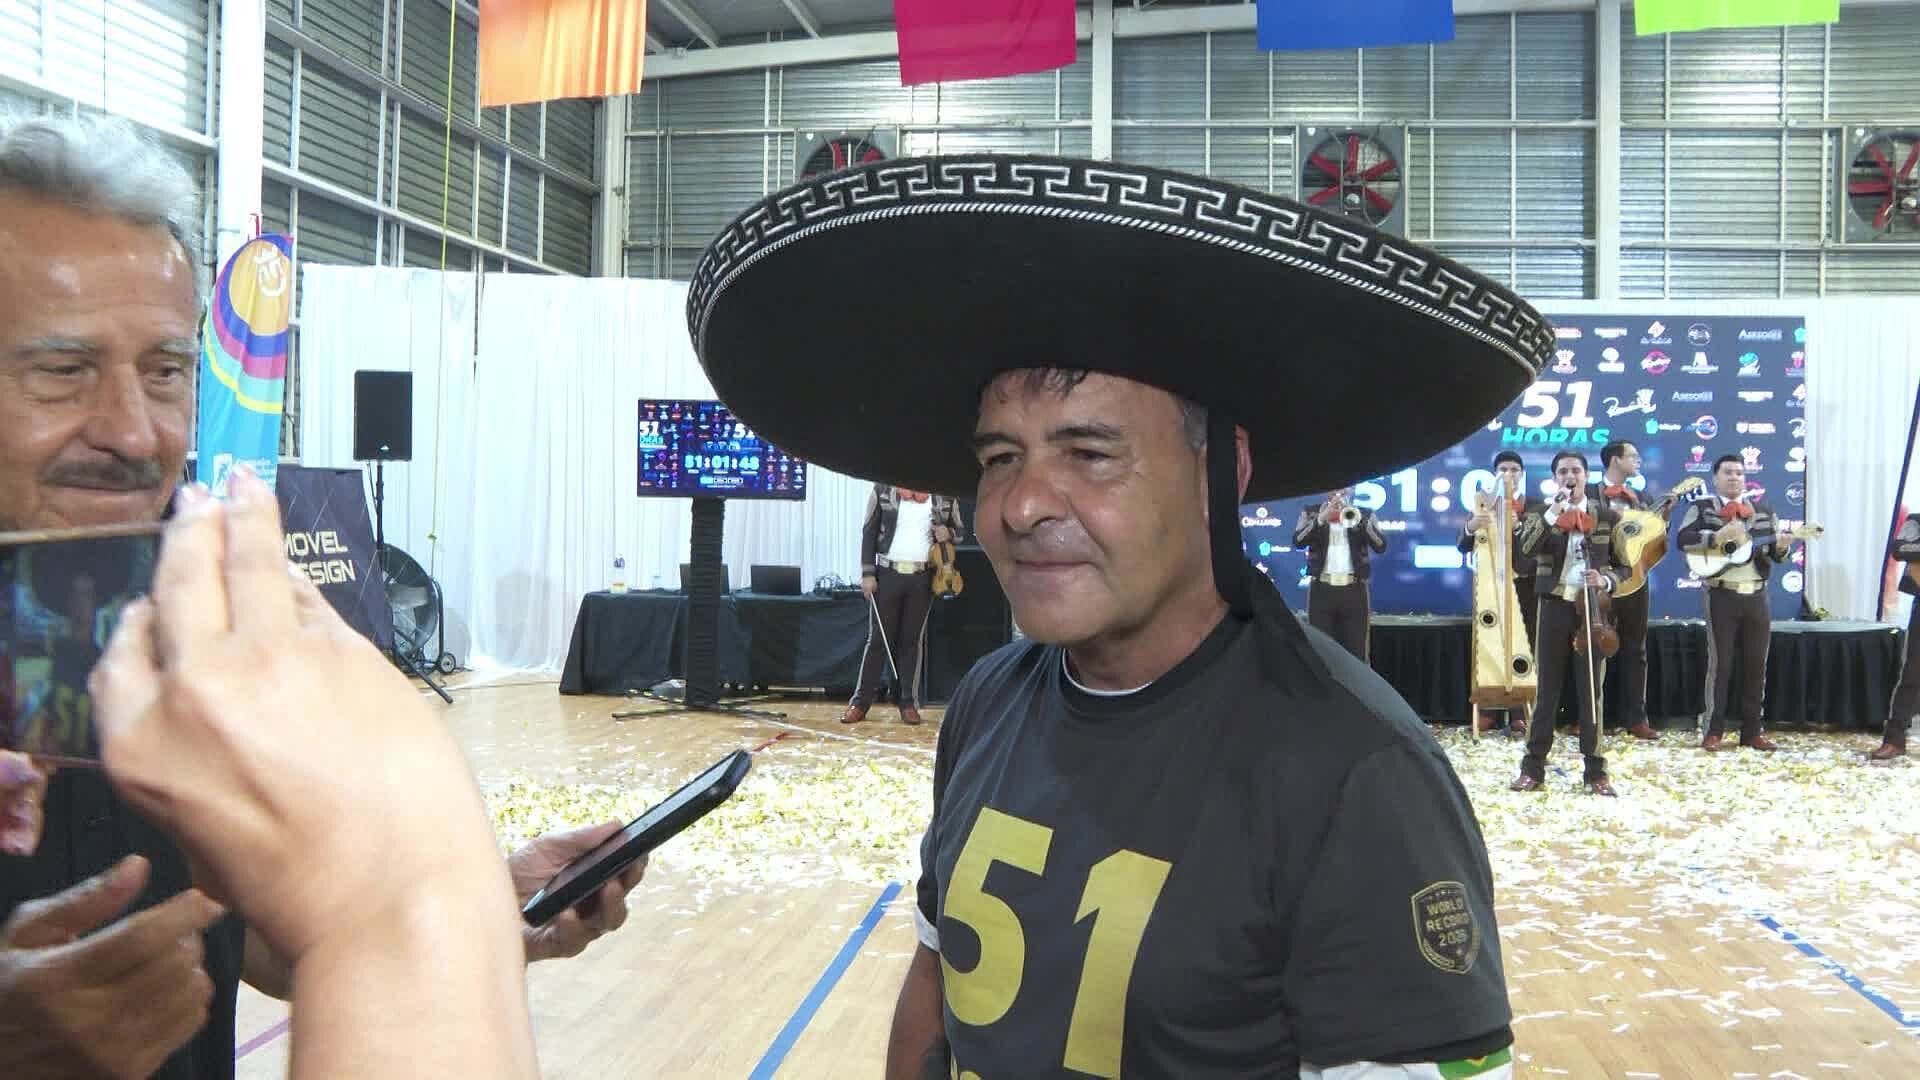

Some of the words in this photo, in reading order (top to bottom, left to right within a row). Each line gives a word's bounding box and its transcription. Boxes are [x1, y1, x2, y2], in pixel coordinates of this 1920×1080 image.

[1517, 381, 1594, 428] 51
[1502, 427, 1610, 448] HORAS
[940, 806, 1173, 1079] 51
